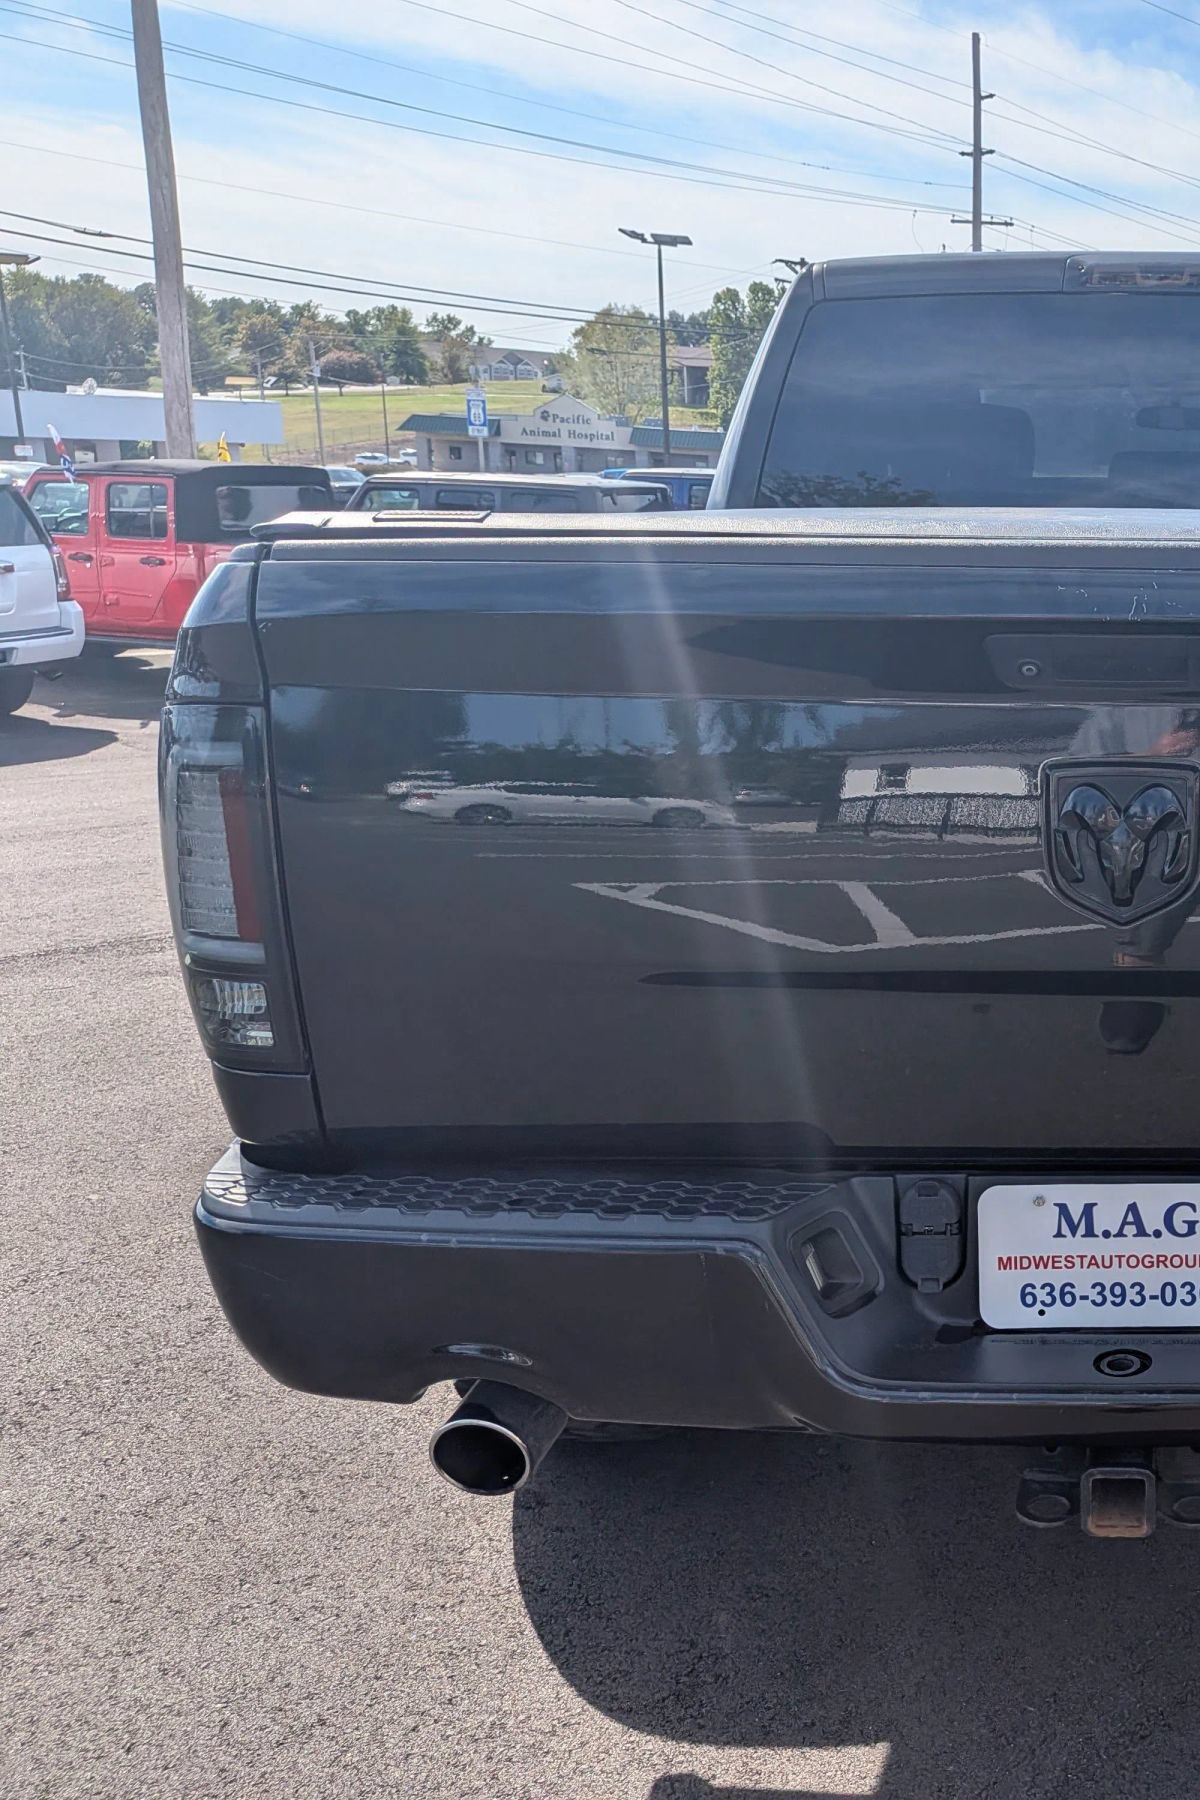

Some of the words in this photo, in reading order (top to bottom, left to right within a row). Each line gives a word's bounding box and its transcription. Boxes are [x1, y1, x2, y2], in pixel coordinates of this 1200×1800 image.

[552, 413, 592, 425] Pacific
[521, 427, 562, 439] Animal
[567, 429, 615, 442] Hospital
[1052, 1201, 1200, 1239] M.A.G
